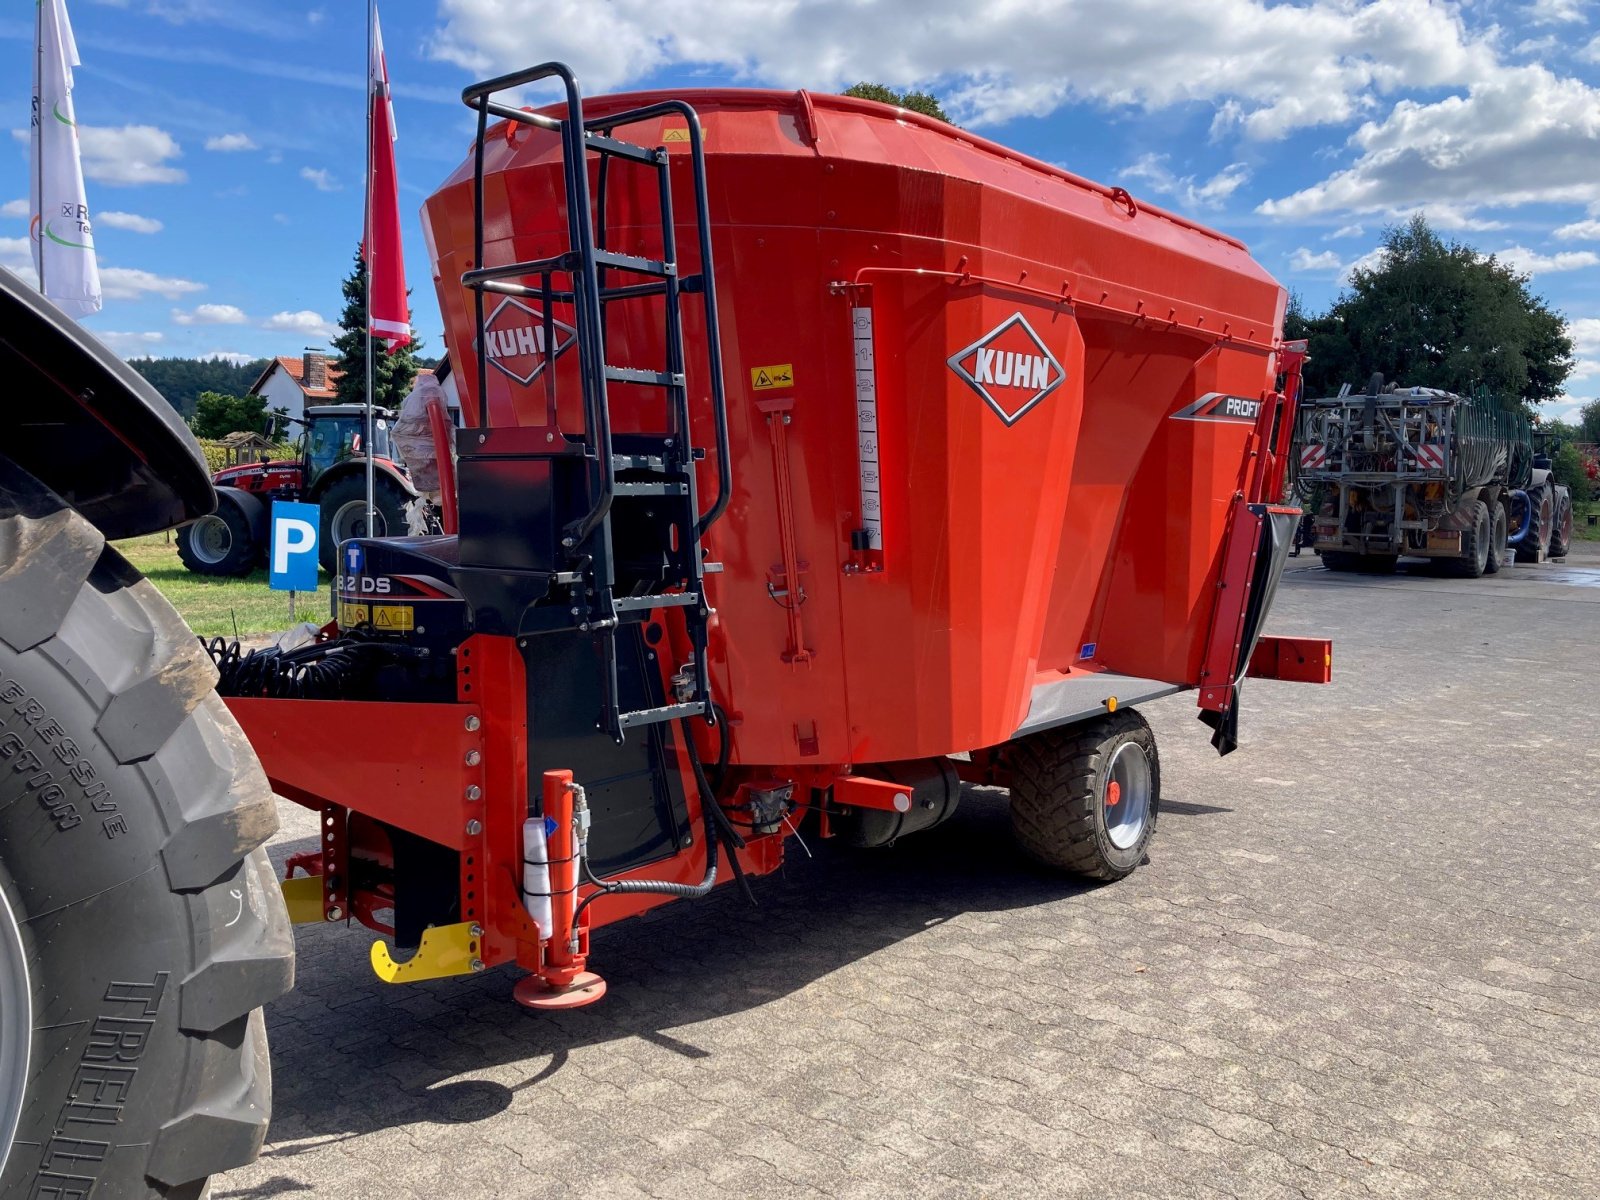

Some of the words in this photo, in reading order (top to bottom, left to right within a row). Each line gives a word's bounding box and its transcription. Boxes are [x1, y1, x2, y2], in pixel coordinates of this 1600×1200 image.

[860, 348, 868, 360] 1
[974, 347, 1050, 390] KUHN
[1226, 397, 1260, 418] PROFI
[860, 410, 873, 423] 3
[863, 440, 874, 454] 4
[863, 471, 876, 484] 5
[864, 498, 877, 511] 6
[274, 517, 316, 574] P
[361, 576, 391, 593] DS
[0, 669, 128, 839] GRESSIVE
